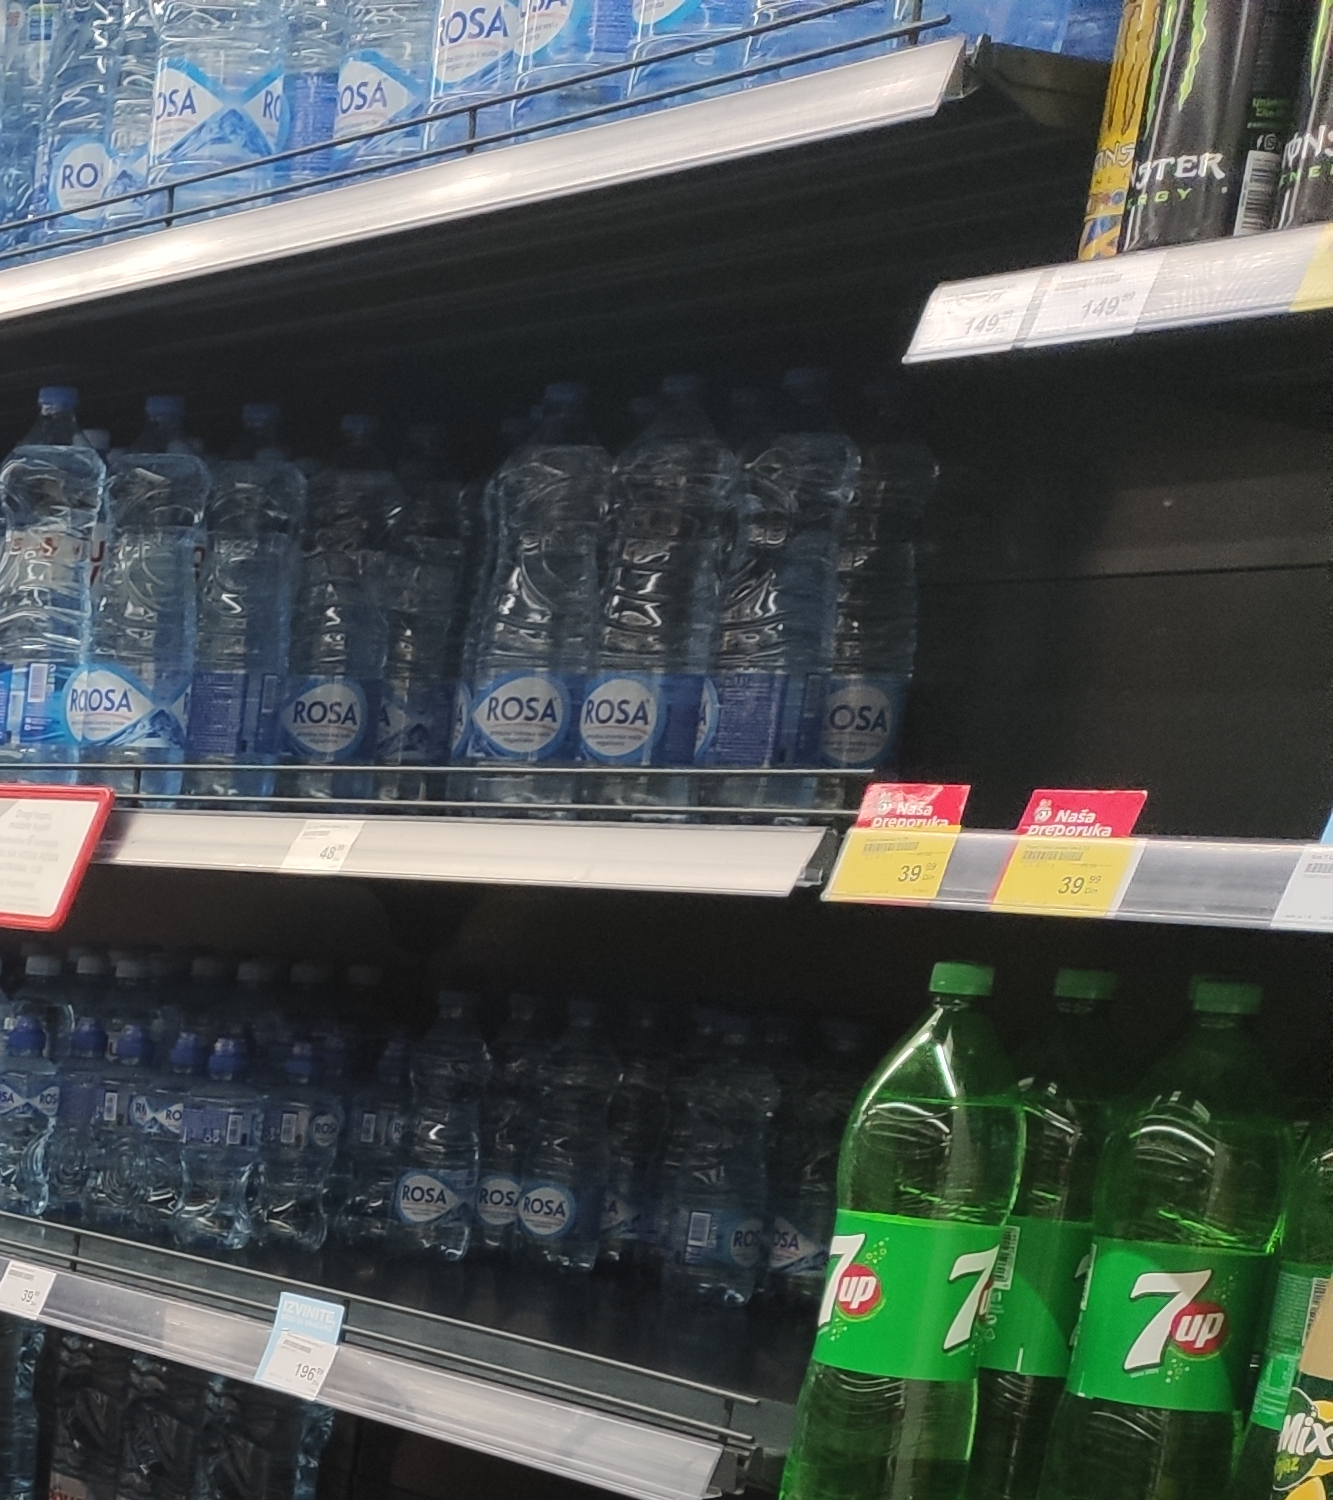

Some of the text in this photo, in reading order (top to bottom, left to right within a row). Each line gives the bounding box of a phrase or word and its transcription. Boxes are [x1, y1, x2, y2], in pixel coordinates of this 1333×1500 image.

[61, 162, 101, 190] RO
[1135, 152, 1226, 191] STER
[292, 699, 358, 727] ROSA
[486, 696, 558, 724] ROSA
[584, 698, 651, 726] ROSA
[895, 801, 933, 817] Naša
[1054, 809, 1097, 824] Naša
[1027, 824, 1113, 838] preporuka
[896, 864, 923, 883] 39
[1057, 875, 1085, 895] 39
[401, 1184, 447, 1204] ROSA
[523, 1196, 566, 1217] ROSA
[838, 1276, 878, 1309] up
[943, 1244, 999, 1350] 7
[1124, 1269, 1226, 1371] 7 up
[294, 1363, 316, 1381] 196
